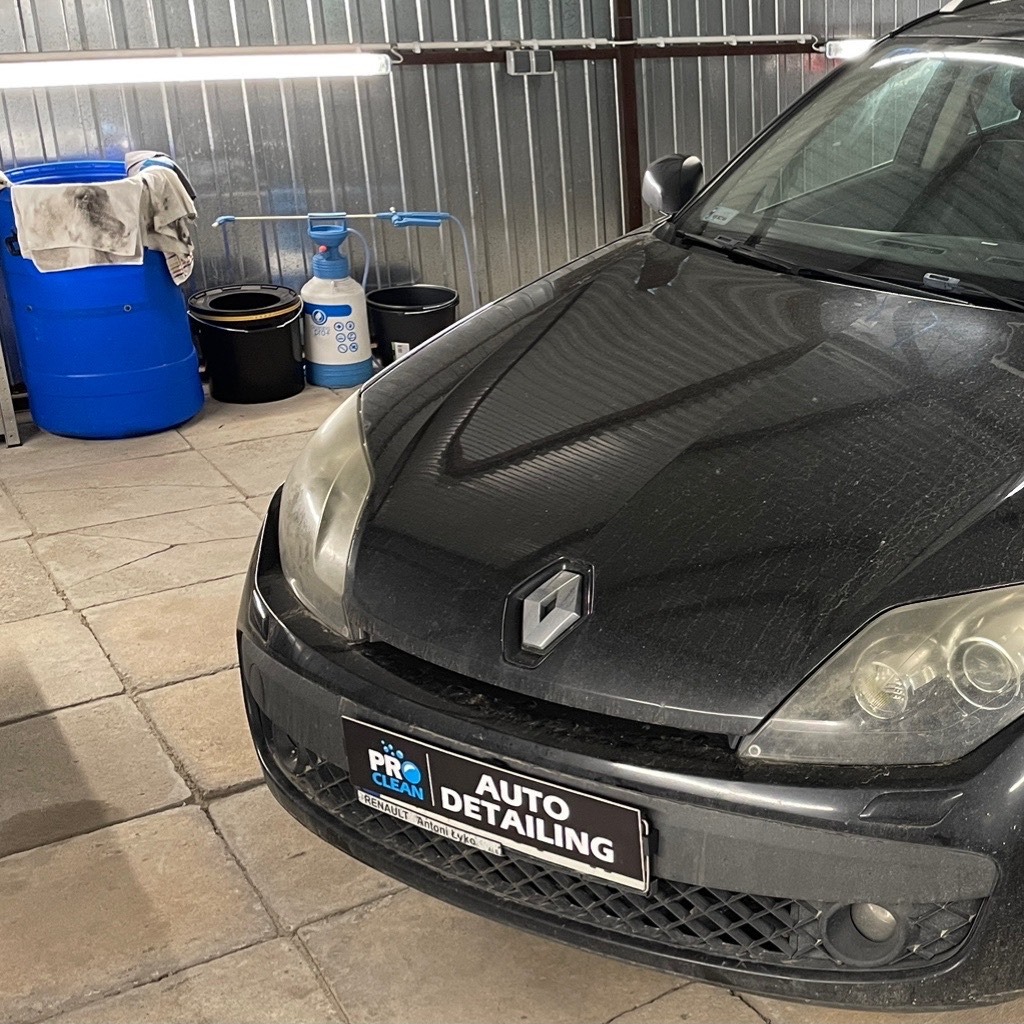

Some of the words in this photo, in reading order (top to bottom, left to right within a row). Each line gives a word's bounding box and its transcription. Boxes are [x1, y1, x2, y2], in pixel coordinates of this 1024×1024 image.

[368, 748, 421, 784] PRO
[372, 772, 424, 800] CLEAN
[364, 794, 409, 820] RENAULT
[416, 815, 448, 836] Antoni
[475, 774, 570, 821] AUTO
[440, 786, 615, 863] DETAILING
